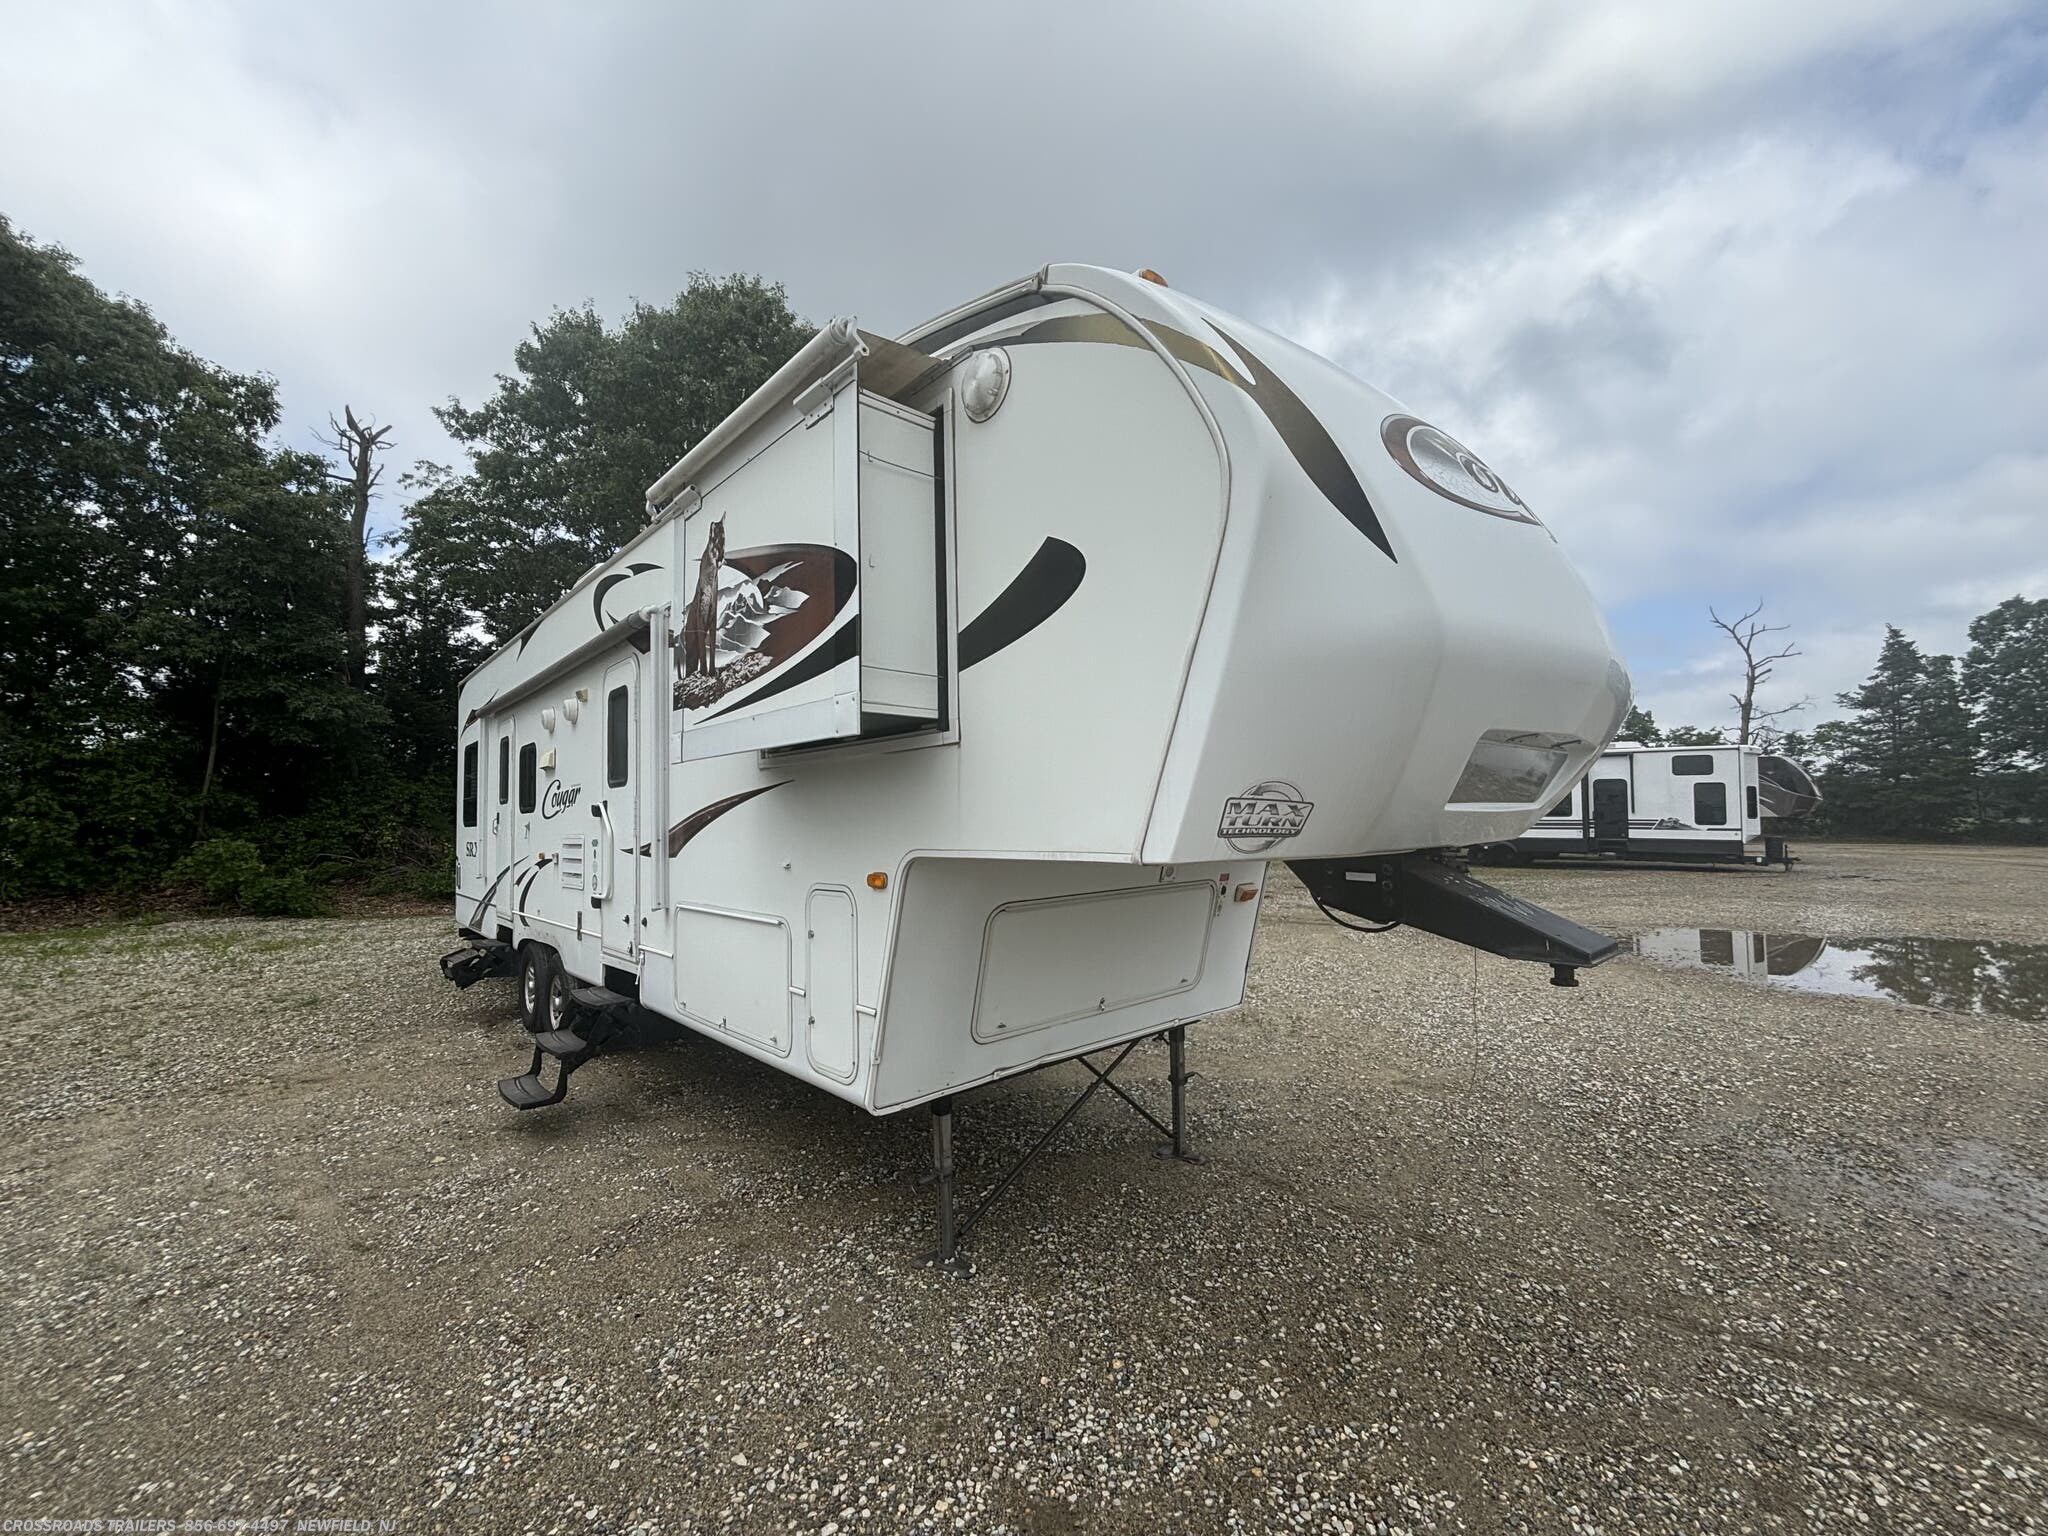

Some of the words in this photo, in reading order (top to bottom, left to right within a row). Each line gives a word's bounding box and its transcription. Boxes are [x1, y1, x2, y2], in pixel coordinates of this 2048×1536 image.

[542, 779, 582, 820] Cougar
[1226, 802, 1311, 817] MAX
[1225, 815, 1304, 827] TURN
